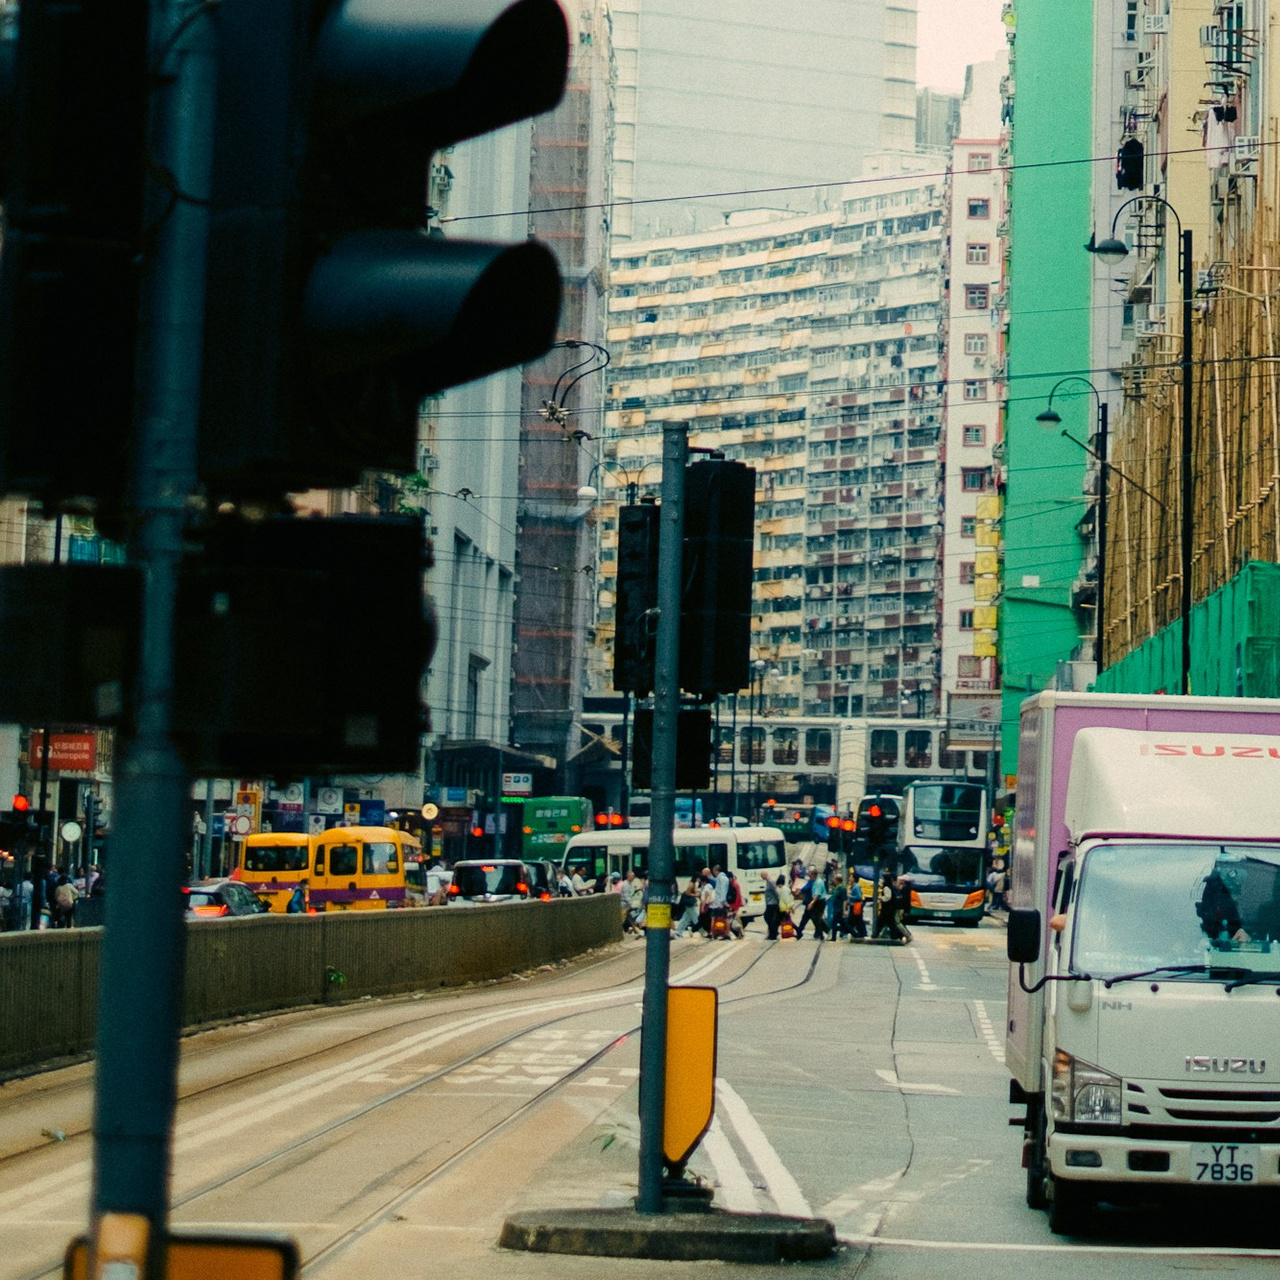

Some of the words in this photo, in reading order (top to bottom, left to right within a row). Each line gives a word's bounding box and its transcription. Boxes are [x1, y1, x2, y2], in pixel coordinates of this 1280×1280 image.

[1185, 1055, 1267, 1074] ISUZU
[1211, 1145, 1239, 1163] YT
[1196, 1163, 1254, 1181] 7836
